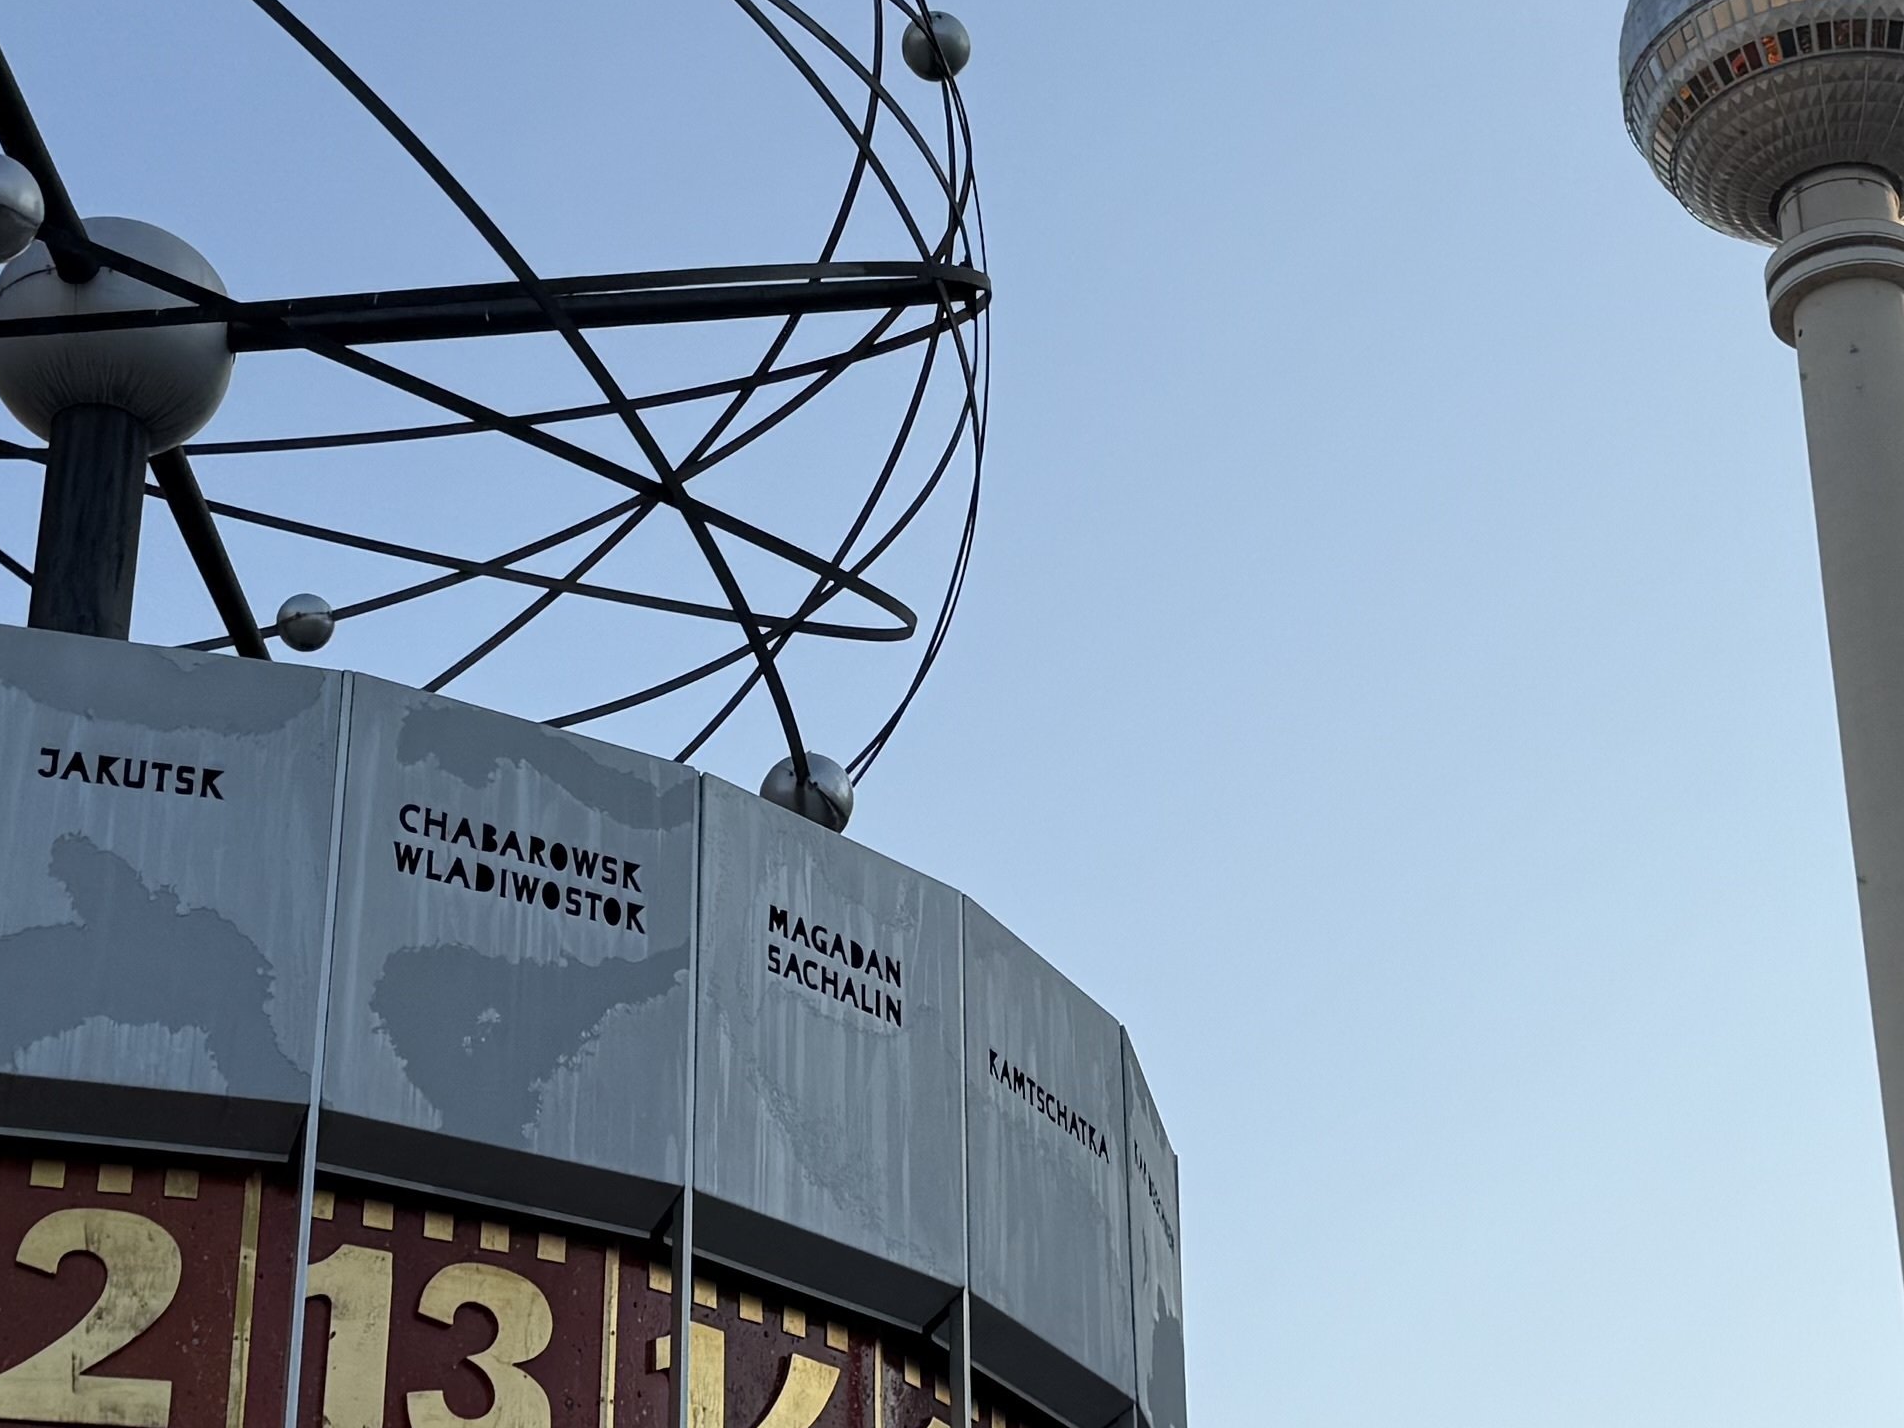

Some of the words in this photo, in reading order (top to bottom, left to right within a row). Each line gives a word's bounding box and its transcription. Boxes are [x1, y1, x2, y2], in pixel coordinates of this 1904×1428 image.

[37, 747, 225, 801] JAKUTSK
[394, 840, 645, 934] WLADIWOSTOK
[399, 803, 642, 892] CHABAROWSK
[767, 944, 902, 1027] SACHALIN
[769, 905, 901, 988] MAGADAN
[989, 1048, 1110, 1164] KAMTSCHATKA
